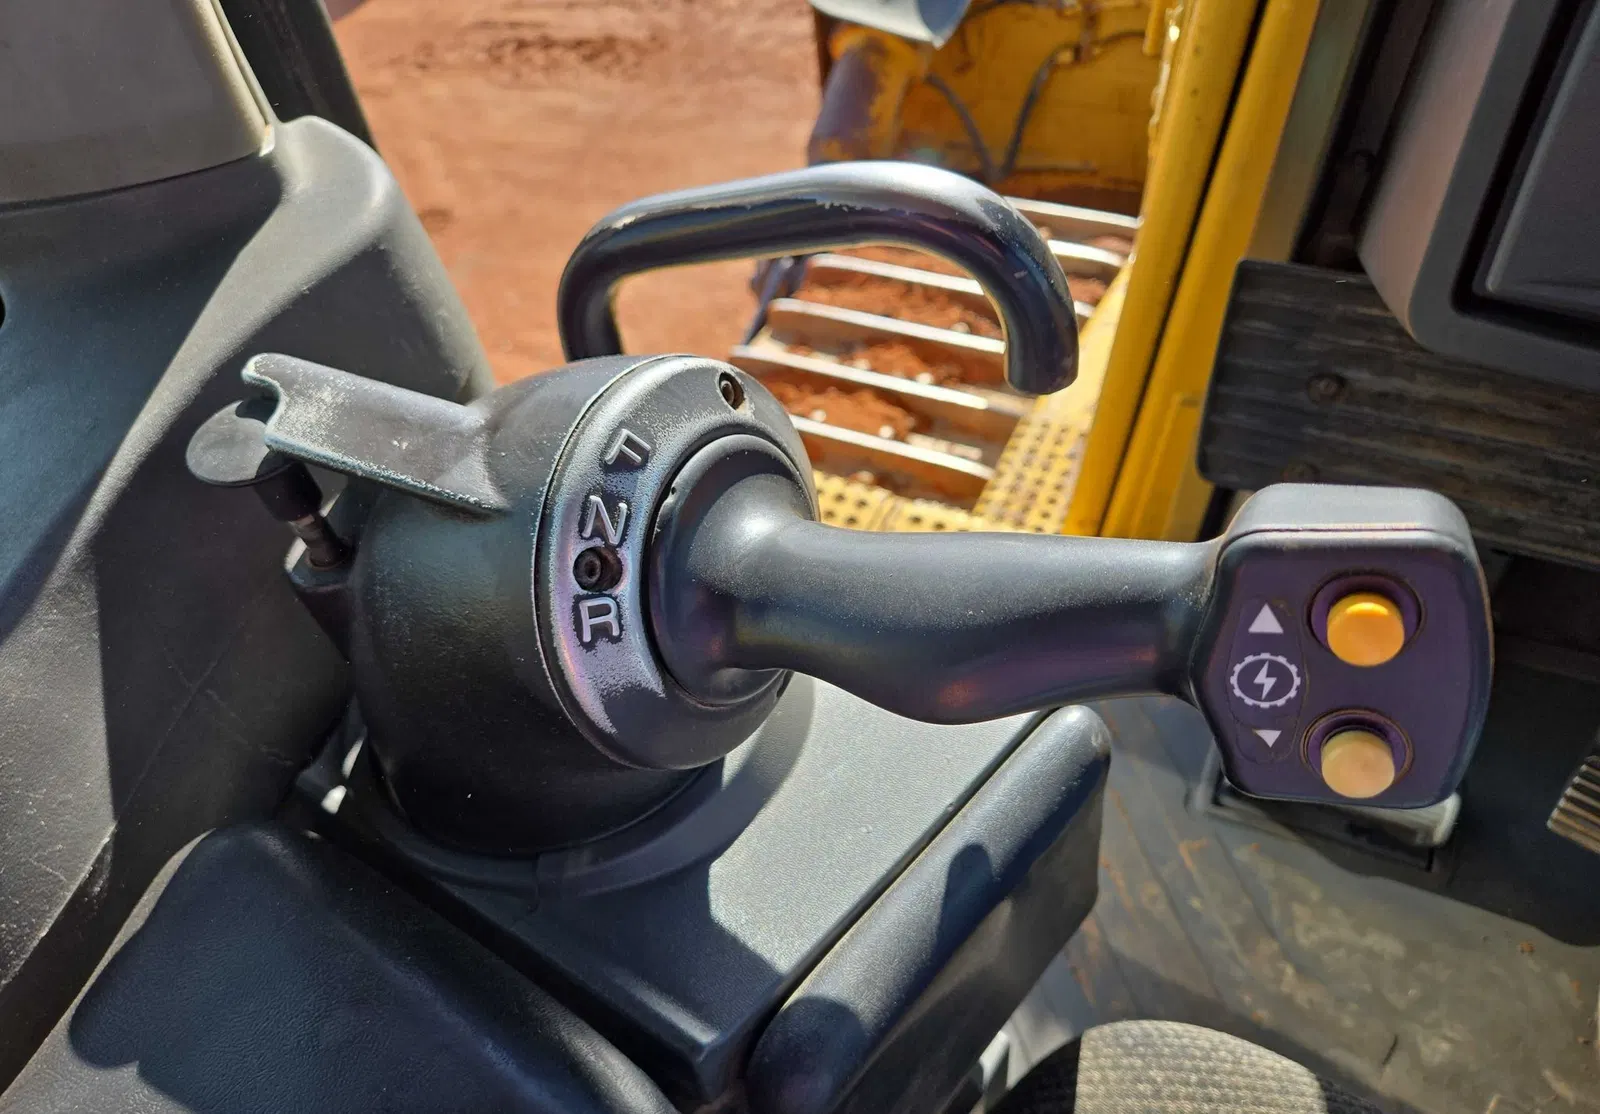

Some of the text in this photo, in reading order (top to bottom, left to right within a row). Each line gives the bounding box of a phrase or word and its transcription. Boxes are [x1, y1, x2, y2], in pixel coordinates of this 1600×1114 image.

[604, 428, 651, 465] F
[581, 495, 628, 545] N
[579, 596, 620, 643] R
